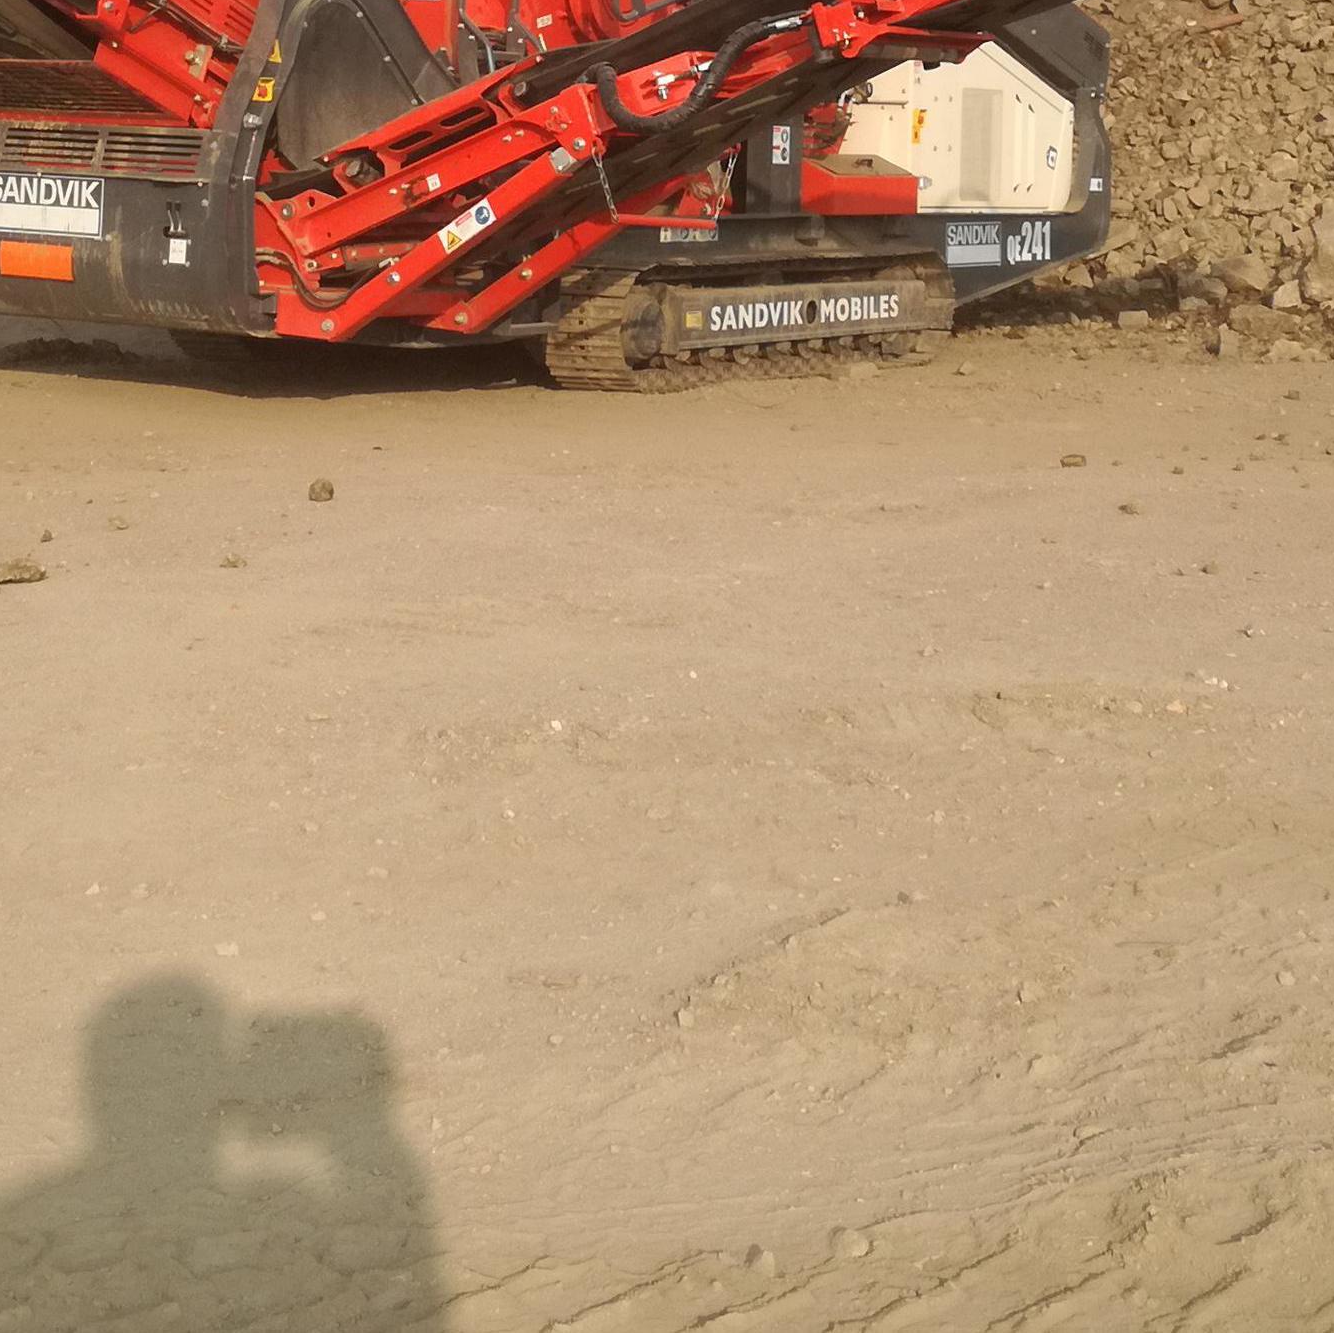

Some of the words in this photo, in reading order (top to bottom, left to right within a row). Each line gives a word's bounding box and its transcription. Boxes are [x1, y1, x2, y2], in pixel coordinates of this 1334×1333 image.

[947, 224, 1000, 245] SANDVIK
[1007, 221, 1051, 265] QE241
[710, 300, 804, 331] SANDVIK
[820, 292, 900, 323] MOBILES
